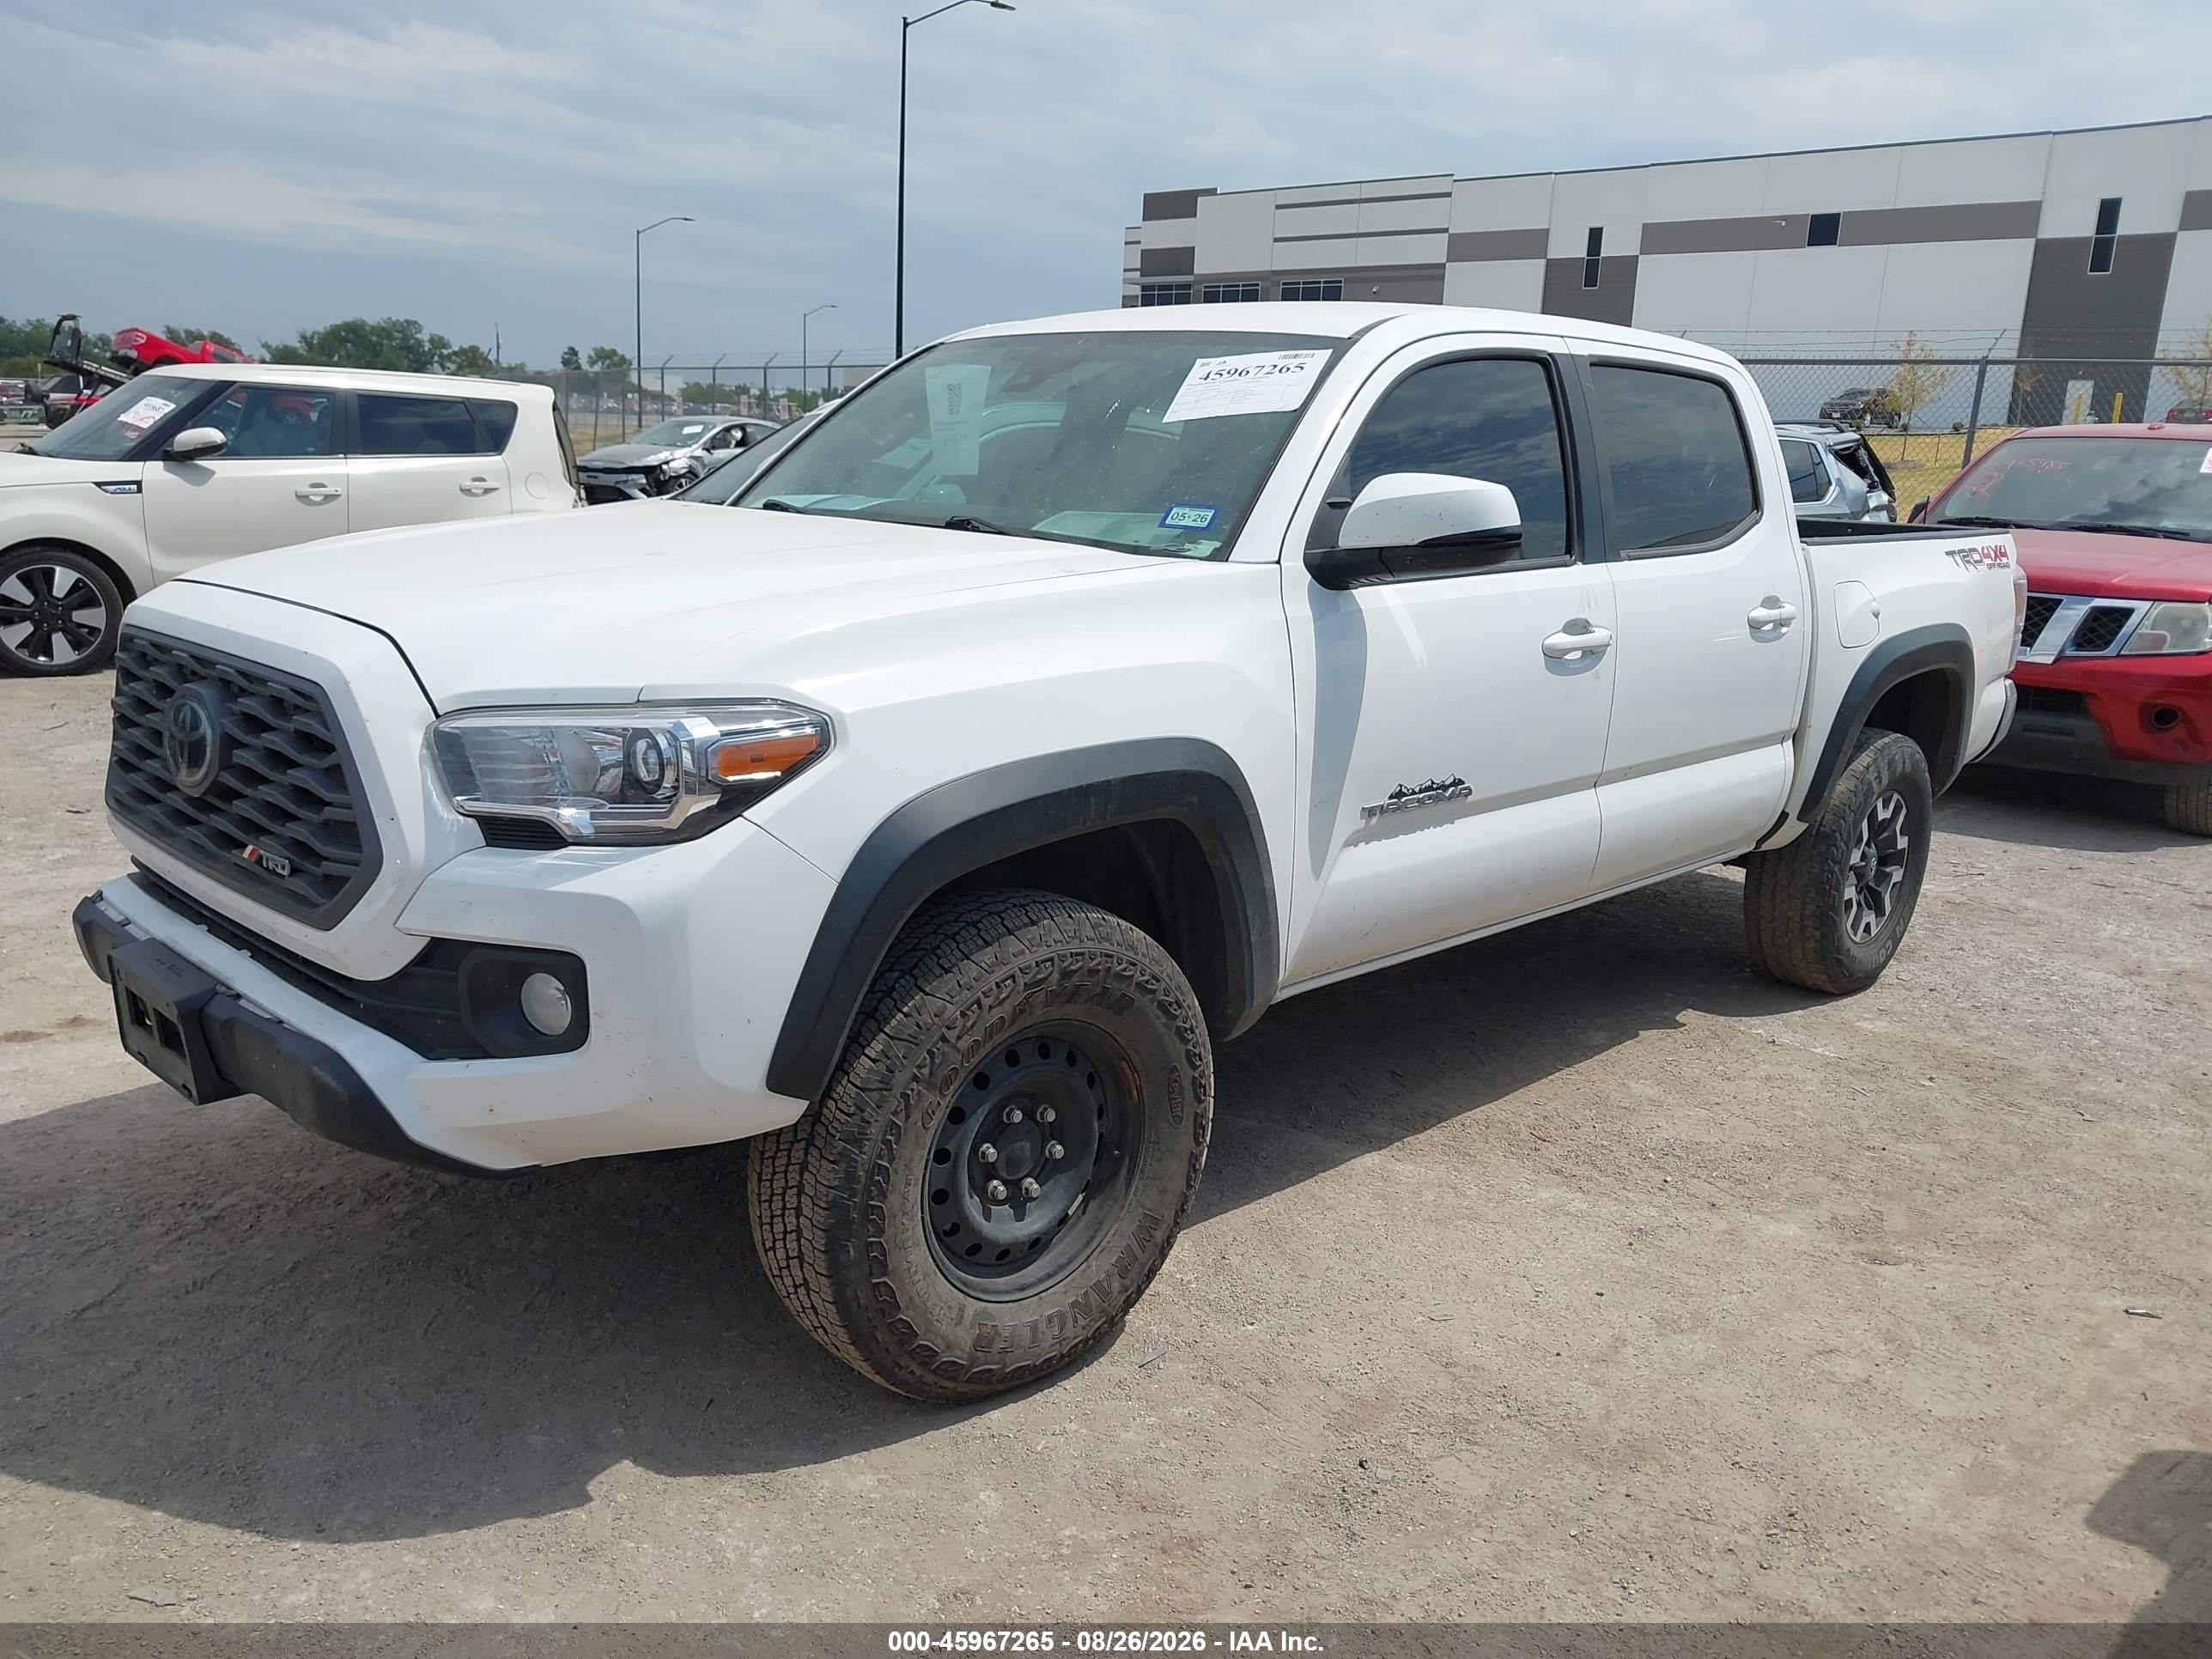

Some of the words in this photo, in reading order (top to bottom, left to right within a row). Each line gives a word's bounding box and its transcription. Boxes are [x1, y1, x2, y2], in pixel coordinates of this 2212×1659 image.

[1198, 361, 1307, 382] 45967265
[1170, 512, 1188, 521] 05
[1192, 514, 1209, 523] 26
[1361, 784, 1473, 819] TACOMA
[259, 849, 291, 879] TRD
[973, 1208, 1162, 1354] WRANGLER
